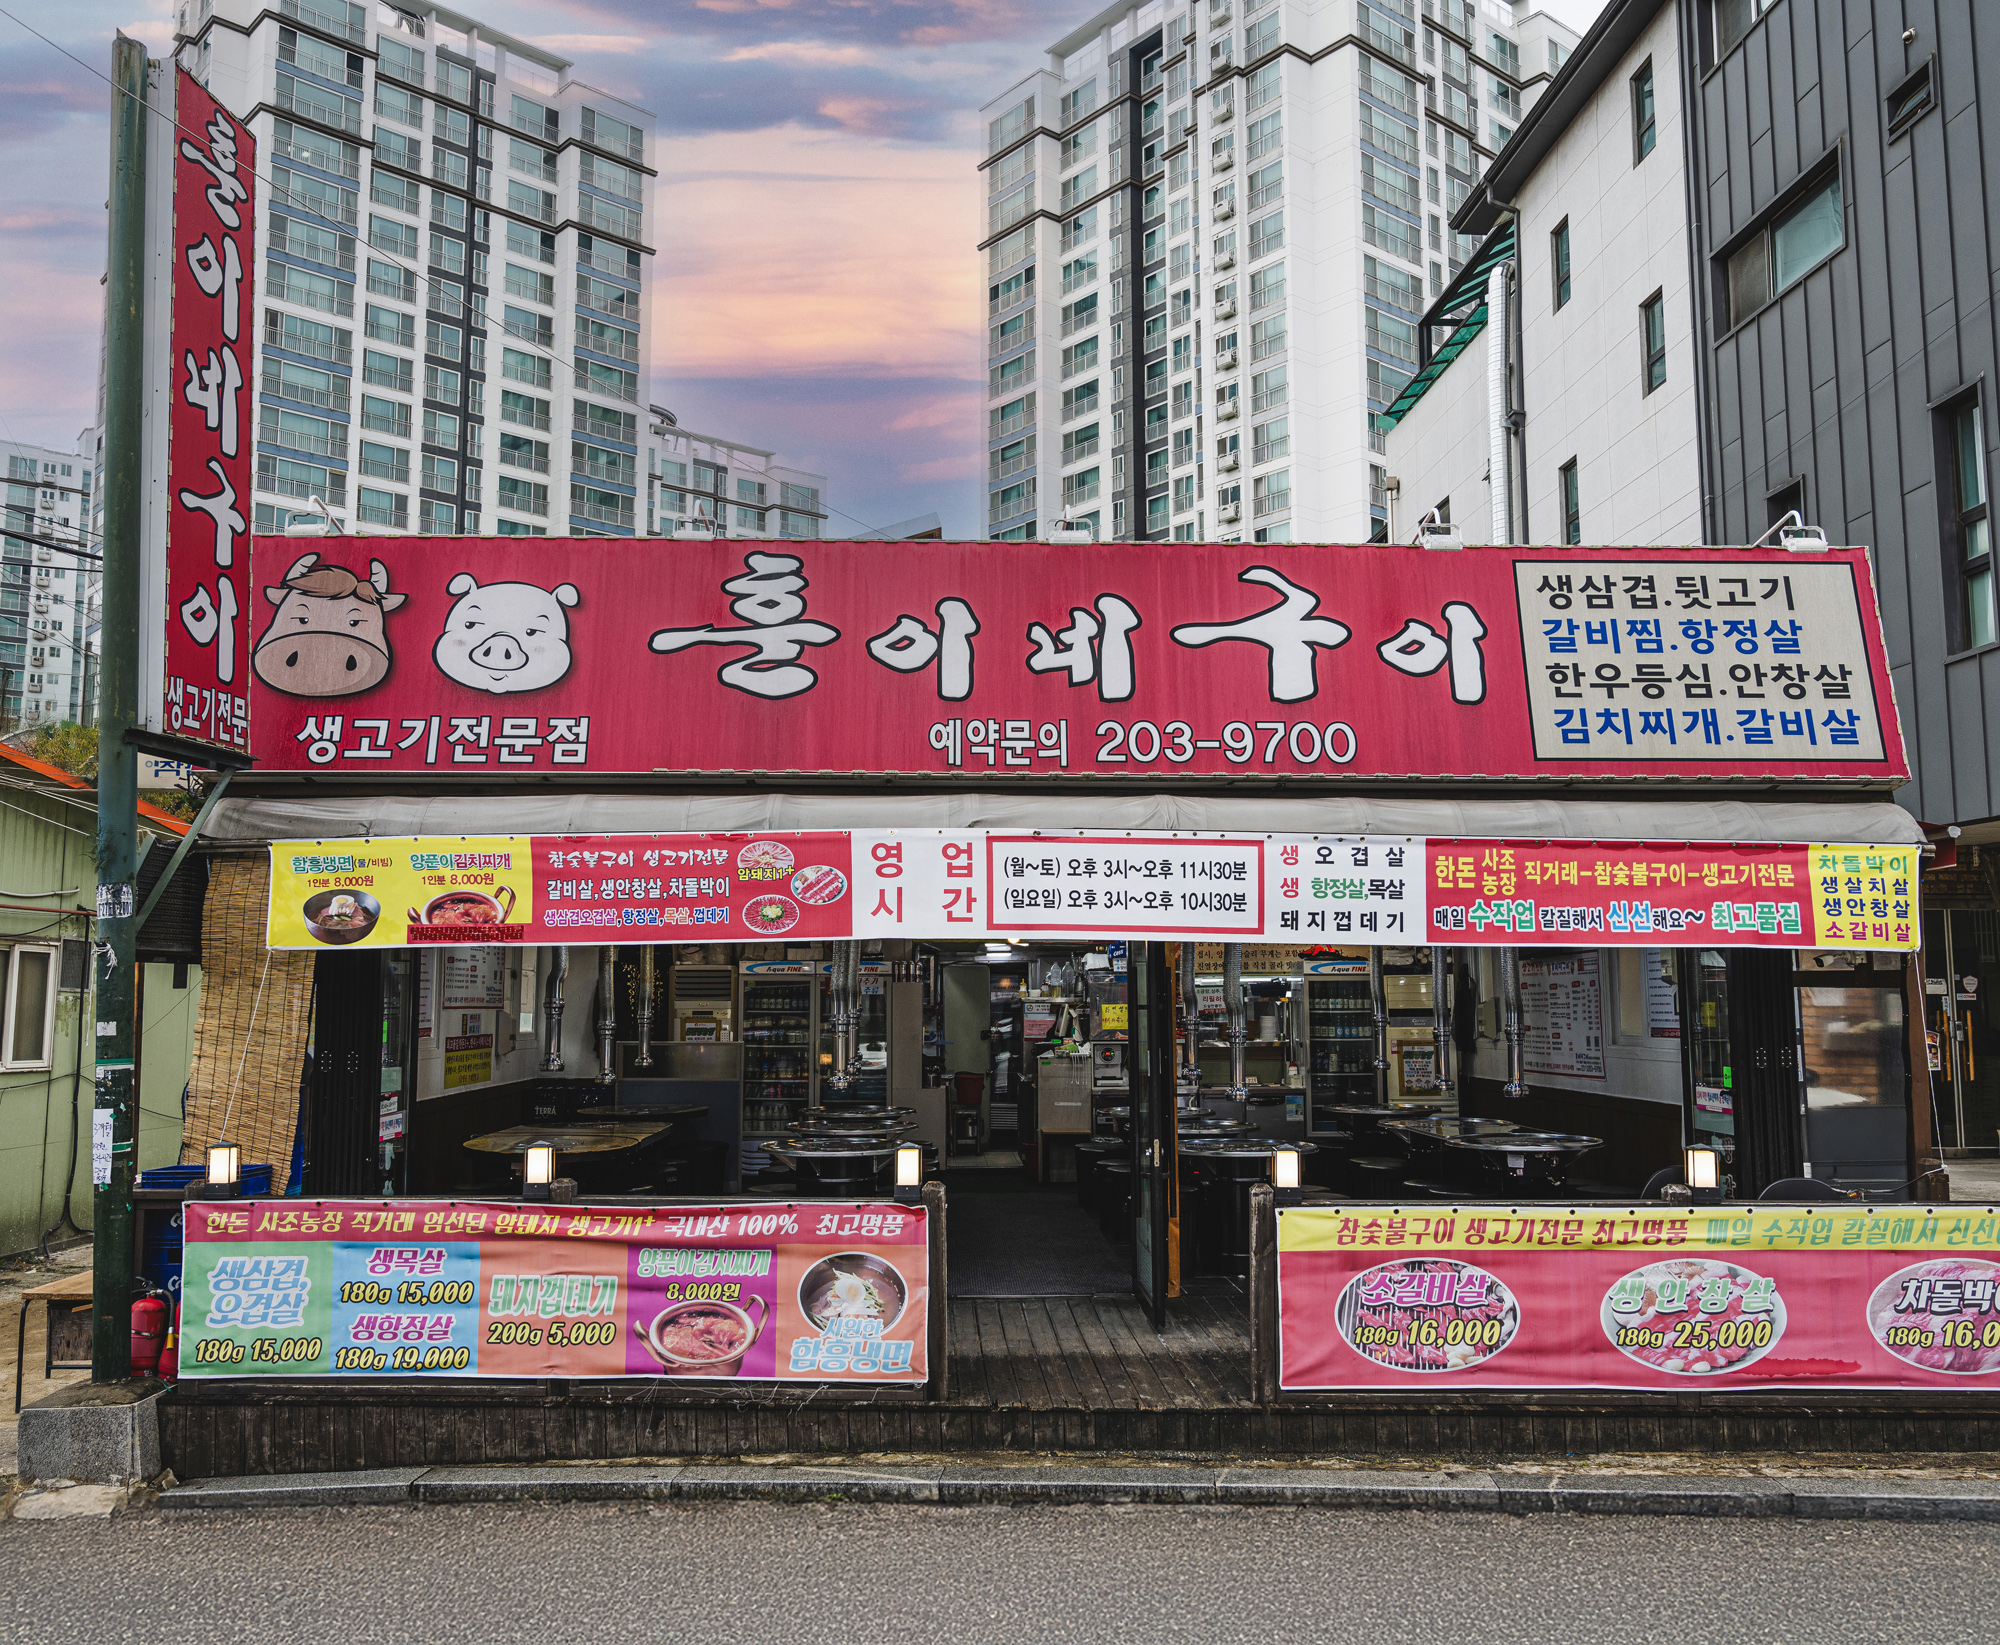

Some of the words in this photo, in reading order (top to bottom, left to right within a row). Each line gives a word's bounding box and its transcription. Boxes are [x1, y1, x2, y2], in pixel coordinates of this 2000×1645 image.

[1536, 574, 1795, 611] 생삼겹.뒷고기
[1542, 618, 1802, 655] 갈비찜.항정살
[1545, 662, 1853, 699] 한우등심.안창살
[166, 674, 248, 746] 생고기전문
[296, 714, 590, 765] 생고기전문점
[1553, 708, 1861, 745] 김치찌개.갈비살
[928, 718, 1069, 767] 예약문의
[1096, 720, 1357, 765] 203-9700
[410, 852, 512, 871] 양푼이김치찌개
[548, 850, 634, 868] 참숯불구이
[643, 849, 729, 867] 생고기전문
[1003, 858, 1061, 880] (월~토)
[1067, 859, 1098, 879] 오후
[1104, 859, 1174, 880] 3시~오후
[1180, 860, 1247, 882] 11시30분
[1435, 855, 1476, 888] 한돈
[1481, 848, 1516, 871] 사조
[1818, 854, 1908, 875] 차돌박이
[307, 878, 331, 888] 1인분
[334, 875, 374, 888] 8,000원
[421, 875, 446, 886] 1인분
[450, 872, 494, 886] 8,000원
[1280, 877, 1300, 898] 생
[1481, 872, 1516, 896] 농장
[1003, 888, 1062, 911] (일요일)
[1067, 890, 1099, 911] 오후
[1104, 889, 1174, 911] 3시~오후
[1180, 891, 1247, 913] 10시30분
[1434, 906, 1465, 930] 매일
[1468, 899, 1535, 932] 수작업
[1538, 906, 1604, 932] 칼질해서
[1711, 900, 1802, 934] 최고품질
[534, 1105, 557, 1116] TERRA
[206, 1211, 249, 1233] 한돈
[255, 1211, 344, 1233] 사조농장
[350, 1211, 416, 1233] 직거래
[422, 1212, 489, 1234] 엄선된
[495, 1213, 560, 1235] 암돼지
[664, 1214, 731, 1238] 국내산
[738, 1213, 799, 1236] 100%
[815, 1213, 906, 1237] 최고명품
[1336, 1217, 1456, 1246] 참숯불구이
[1463, 1217, 1584, 1246] 생고기전문
[1591, 1218, 1689, 1246] 최고명품
[1705, 1217, 1753, 1246] 매일
[1762, 1217, 1834, 1246] 수작업
[1841, 1217, 1940, 1246] 칼질해서
[1946, 1218, 2000, 1246] 신선
[366, 1247, 448, 1276] 생목살
[637, 1248, 772, 1277] 양푼이김치찌개
[340, 1281, 391, 1305] 180g
[397, 1280, 474, 1306] 15,000
[488, 1275, 618, 1319] 돼지껍데기
[666, 1282, 741, 1302] 8,000원
[1362, 1272, 1491, 1308] 소갈비살
[1894, 1278, 2000, 1316] 차돌박
[206, 1292, 308, 1328] 오겹살
[350, 1313, 455, 1343] 생항정살
[487, 1321, 543, 1346] 200g
[547, 1321, 617, 1348] 5,000
[820, 1317, 884, 1340] 시원한
[1354, 1326, 1400, 1347] 180g
[1406, 1319, 1502, 1349] 16,000
[1616, 1326, 1665, 1349] 180g
[1672, 1319, 1773, 1350] 25,000
[1886, 1326, 1935, 1348] 180g
[195, 1339, 246, 1364] 180g
[250, 1337, 322, 1364] 15,000
[335, 1347, 387, 1371] 180g
[393, 1347, 470, 1372] 19,000
[789, 1337, 914, 1373] 함흥냉면
